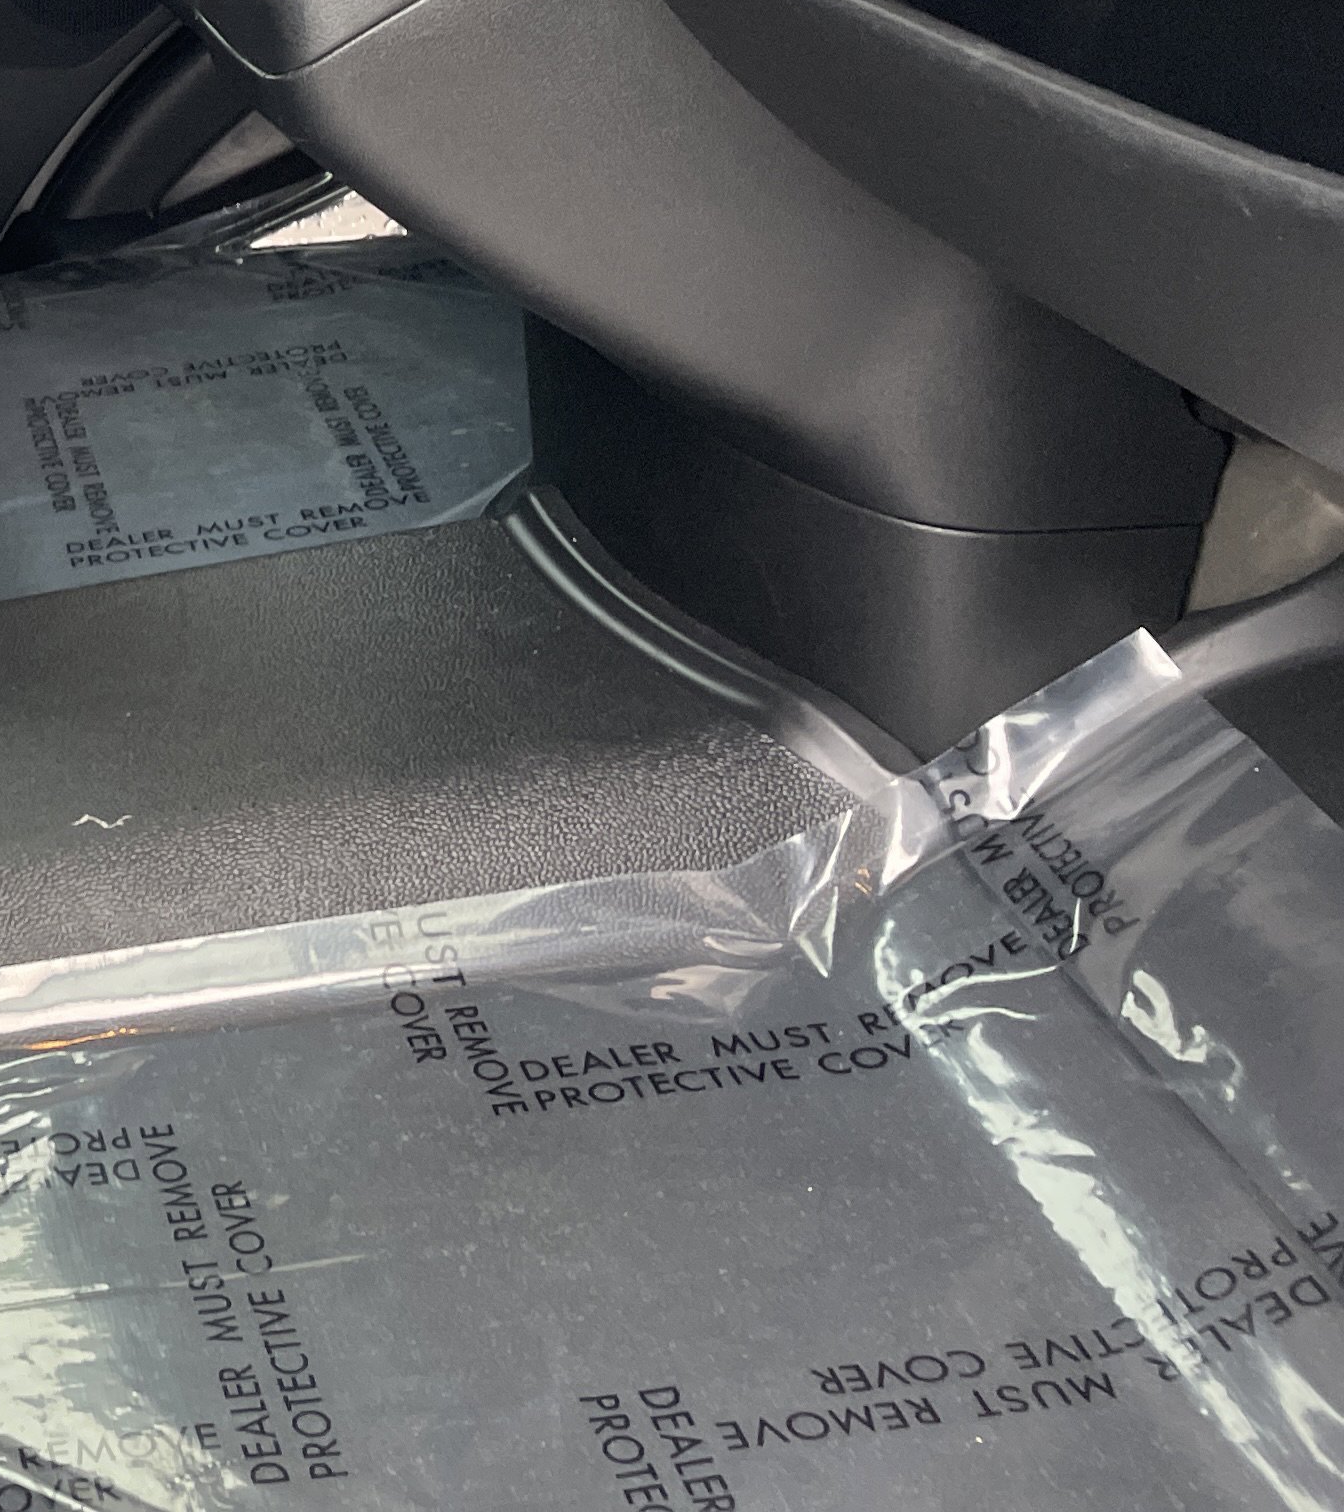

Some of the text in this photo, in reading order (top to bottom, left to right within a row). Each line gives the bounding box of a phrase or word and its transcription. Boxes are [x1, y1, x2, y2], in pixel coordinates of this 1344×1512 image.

[343, 385, 382, 421] COVER
[324, 416, 361, 447] MUST
[68, 445, 101, 477] MUST
[345, 453, 391, 497] DEALER
[45, 472, 77, 514] COVER
[82, 482, 121, 536] REMOVE
[65, 492, 432, 555] DEALER MUST REMOVE
[70, 516, 368, 568] PROTECTIVE COVER
[1002, 867, 1091, 962] DEALER
[382, 962, 449, 1065] COVER
[519, 928, 1029, 1083] DEALER MUST REMOVE
[444, 1004, 530, 1117] REMOVE
[536, 1018, 966, 1112] PROTECTIVE COVER
[139, 1122, 291, 1487] DEALER MUST REMOVE
[210, 1179, 350, 1481] PROTECTIVE COVER
[811, 1349, 986, 1396] COVER
[972, 1371, 1118, 1419] MUST
[18, 1421, 222, 1471] REMOVE
[637, 1385, 736, 1512] DEALER
[714, 1396, 944, 1452] REMOVE
[578, 1393, 674, 1512] PROTE
